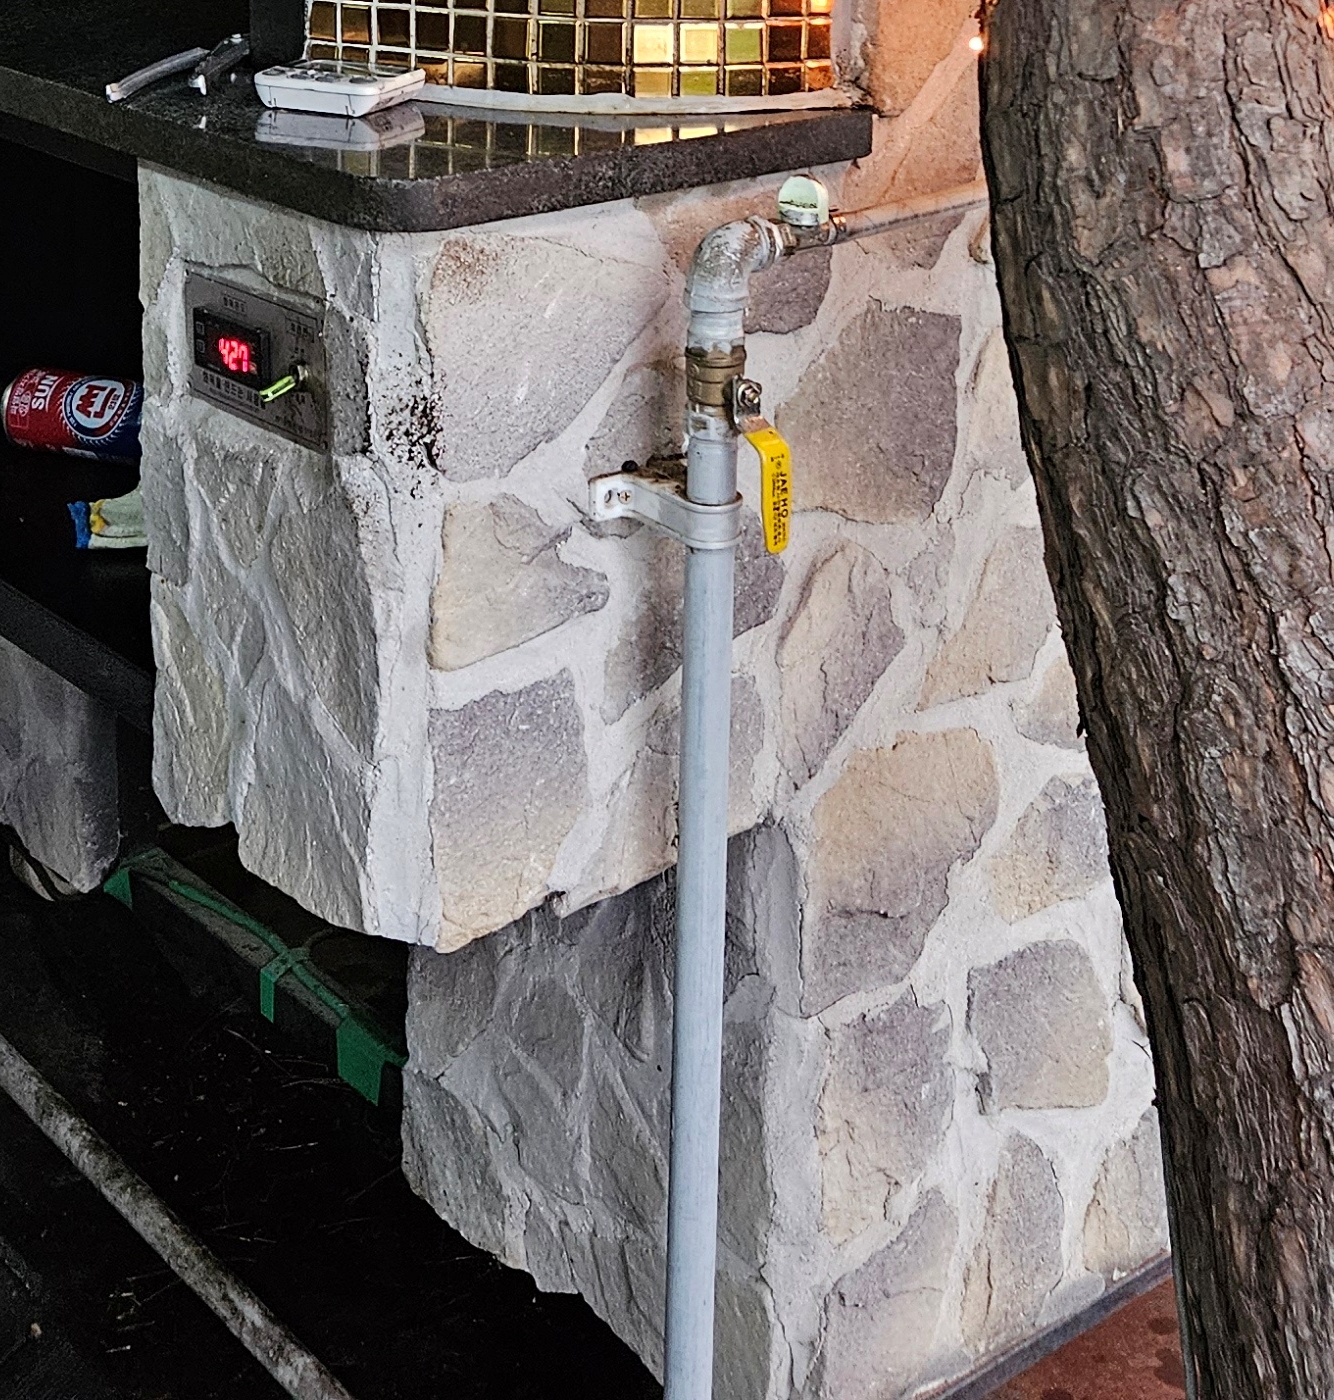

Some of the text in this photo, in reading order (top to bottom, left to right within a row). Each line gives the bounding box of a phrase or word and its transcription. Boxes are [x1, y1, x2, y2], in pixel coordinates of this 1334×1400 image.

[218, 337, 250, 373] 427
[31, 375, 59, 411] SUN
[780, 471, 788, 495] JAE
[780, 497, 789, 518] HO
